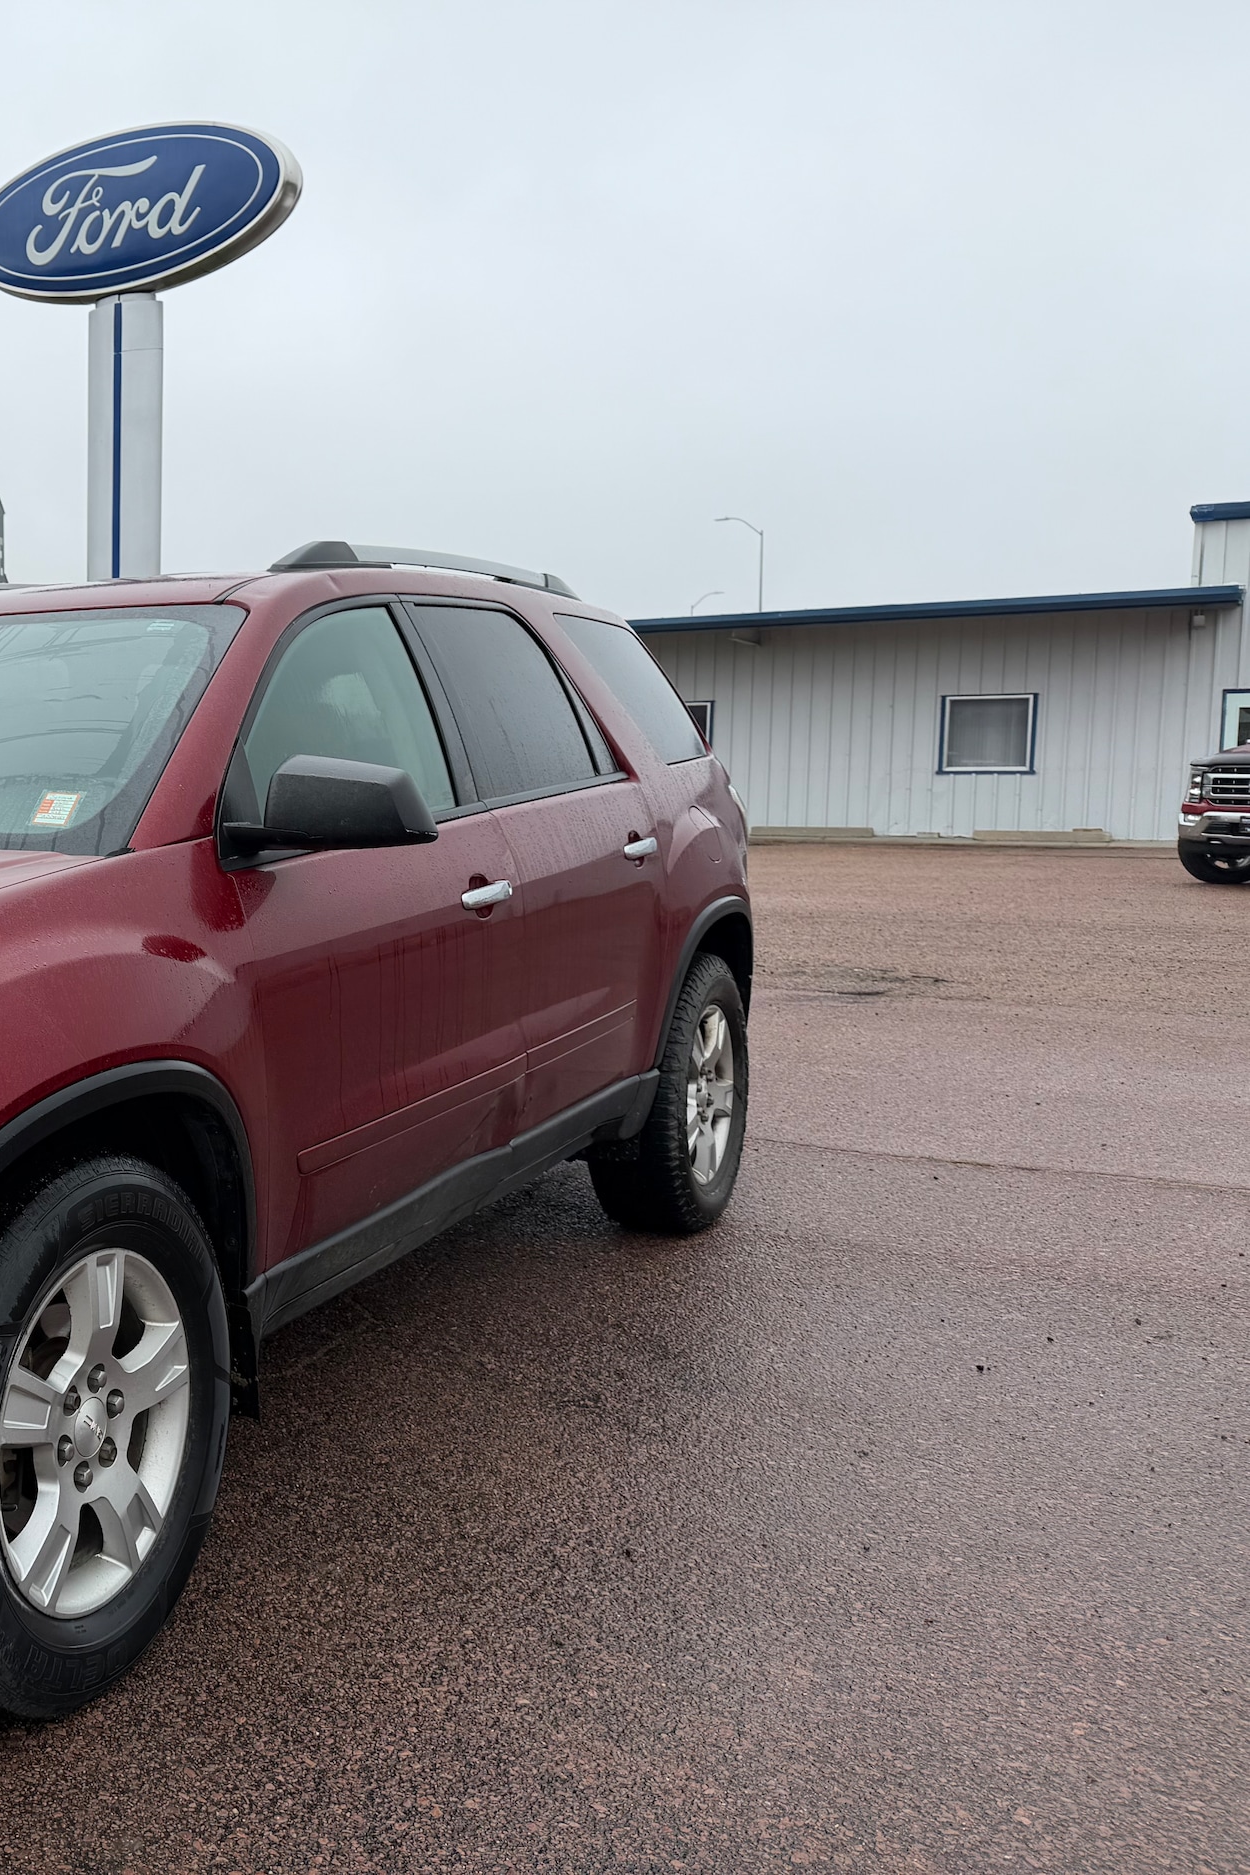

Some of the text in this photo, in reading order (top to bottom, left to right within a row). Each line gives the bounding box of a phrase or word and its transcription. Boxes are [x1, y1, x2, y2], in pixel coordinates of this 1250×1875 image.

[26, 155, 207, 266] Ford
[79, 1192, 207, 1264] SIERRADIAL
[23, 1639, 128, 1690] DELTA
